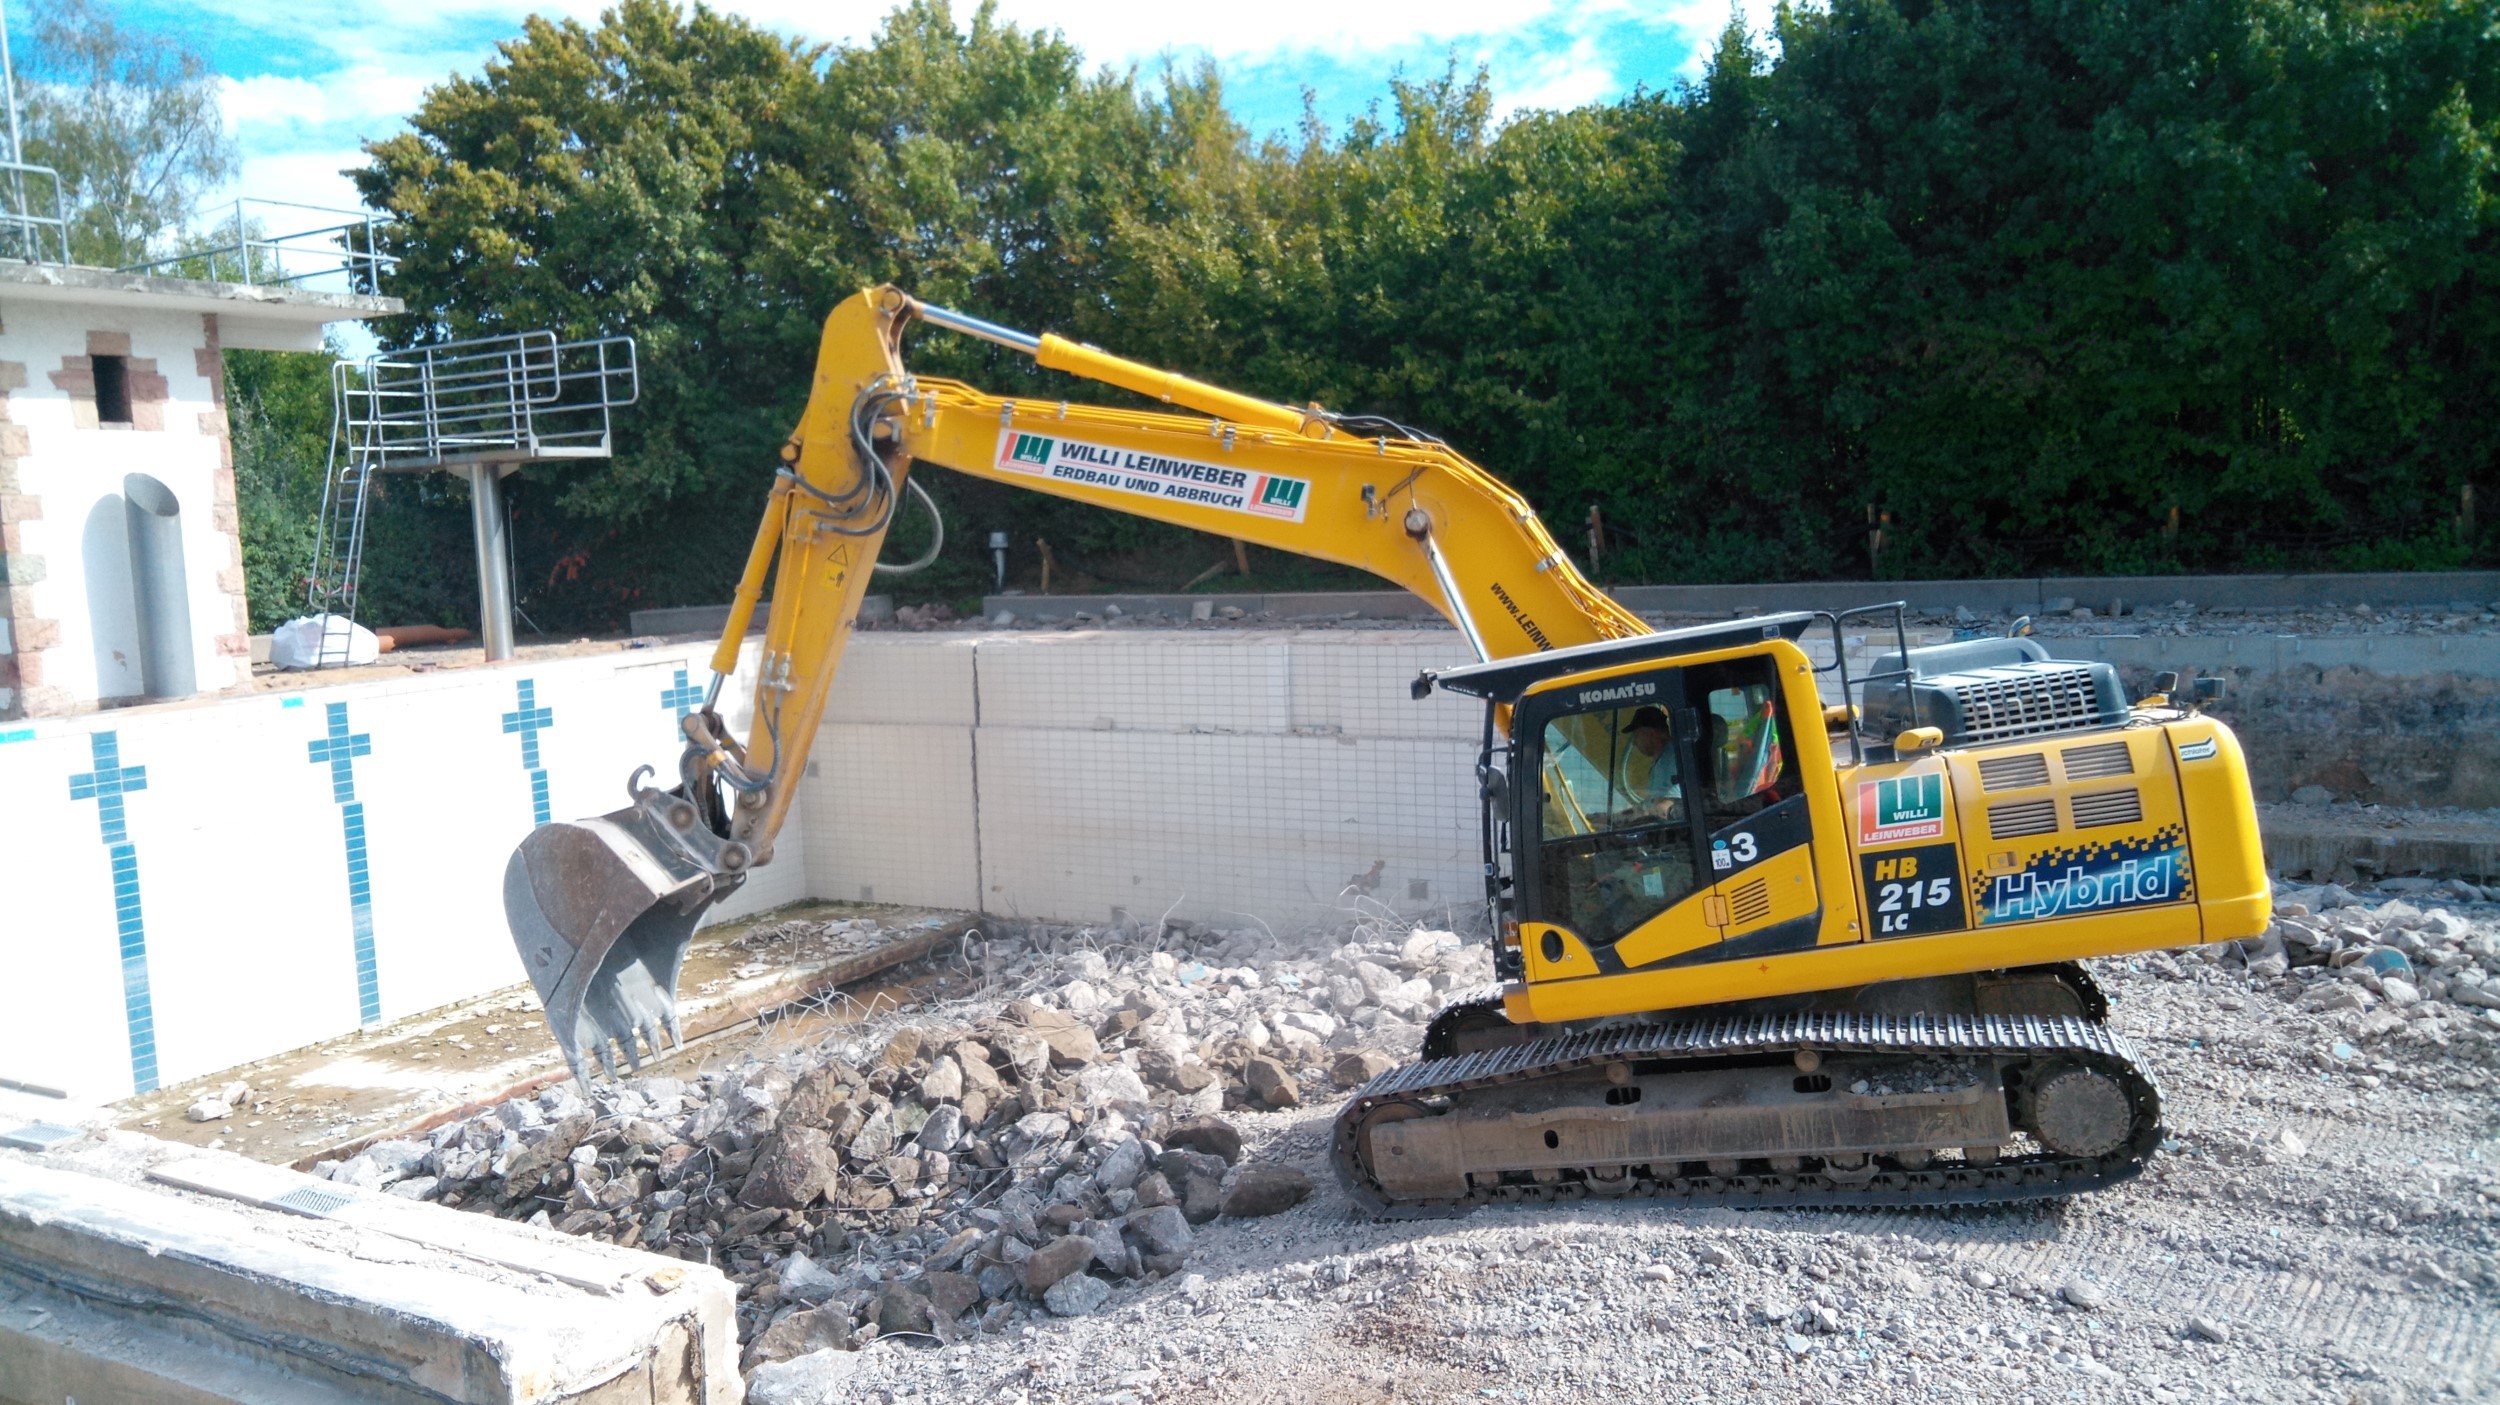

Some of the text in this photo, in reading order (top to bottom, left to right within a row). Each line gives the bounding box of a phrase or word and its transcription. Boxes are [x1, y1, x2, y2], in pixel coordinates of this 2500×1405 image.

[1061, 442, 1247, 489] WILLI LEINWEBER
[1053, 465, 1120, 486] ERDBAU
[1125, 477, 1160, 493] UND
[1164, 484, 1243, 508] ABBRUCH
[1579, 682, 1656, 704] KOMATSU
[1893, 808, 1928, 820] WILLI
[1864, 824, 1937, 842] LEINWEBER
[1731, 832, 1757, 862] 3
[1875, 856, 1917, 881] HB
[1878, 877, 1951, 912] 215
[1995, 855, 2171, 918] Hybrid
[1882, 913, 1909, 932] LC
